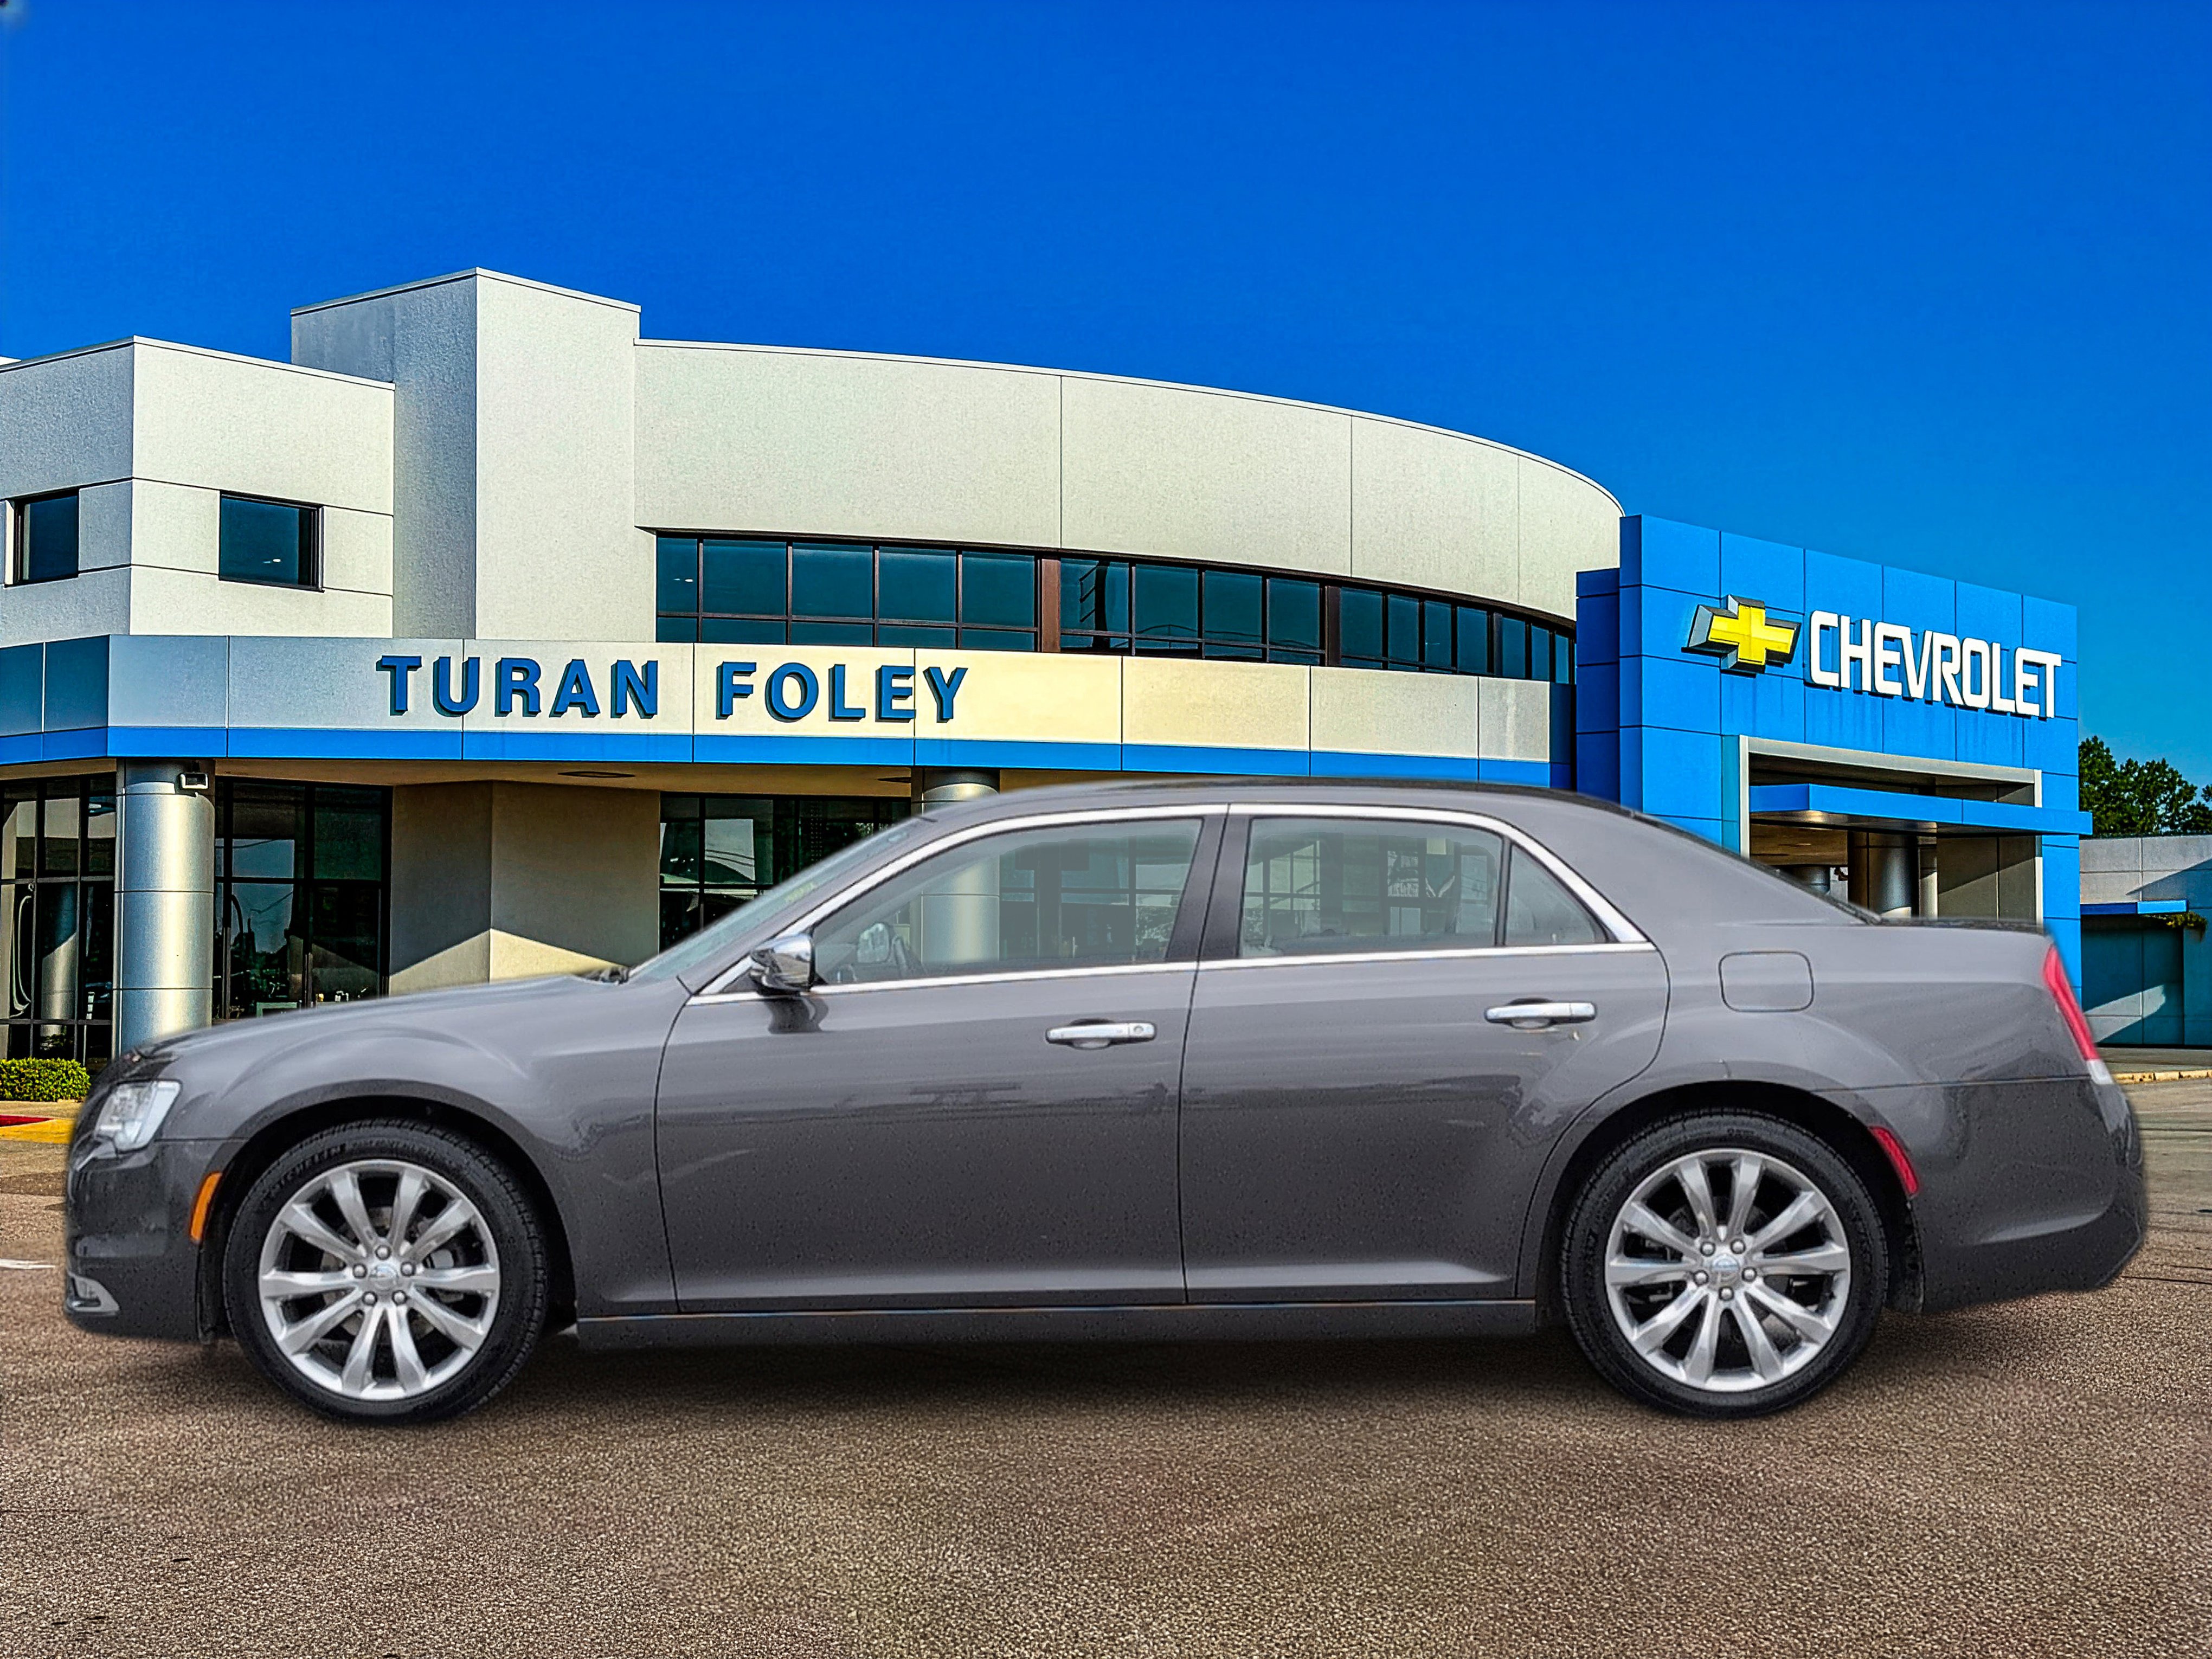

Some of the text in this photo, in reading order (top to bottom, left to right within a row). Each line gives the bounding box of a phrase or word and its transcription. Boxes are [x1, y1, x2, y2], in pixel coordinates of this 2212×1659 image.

[376, 655, 968, 723] TURAN FOLEY
[1810, 610, 2061, 718] CHEVROLET
